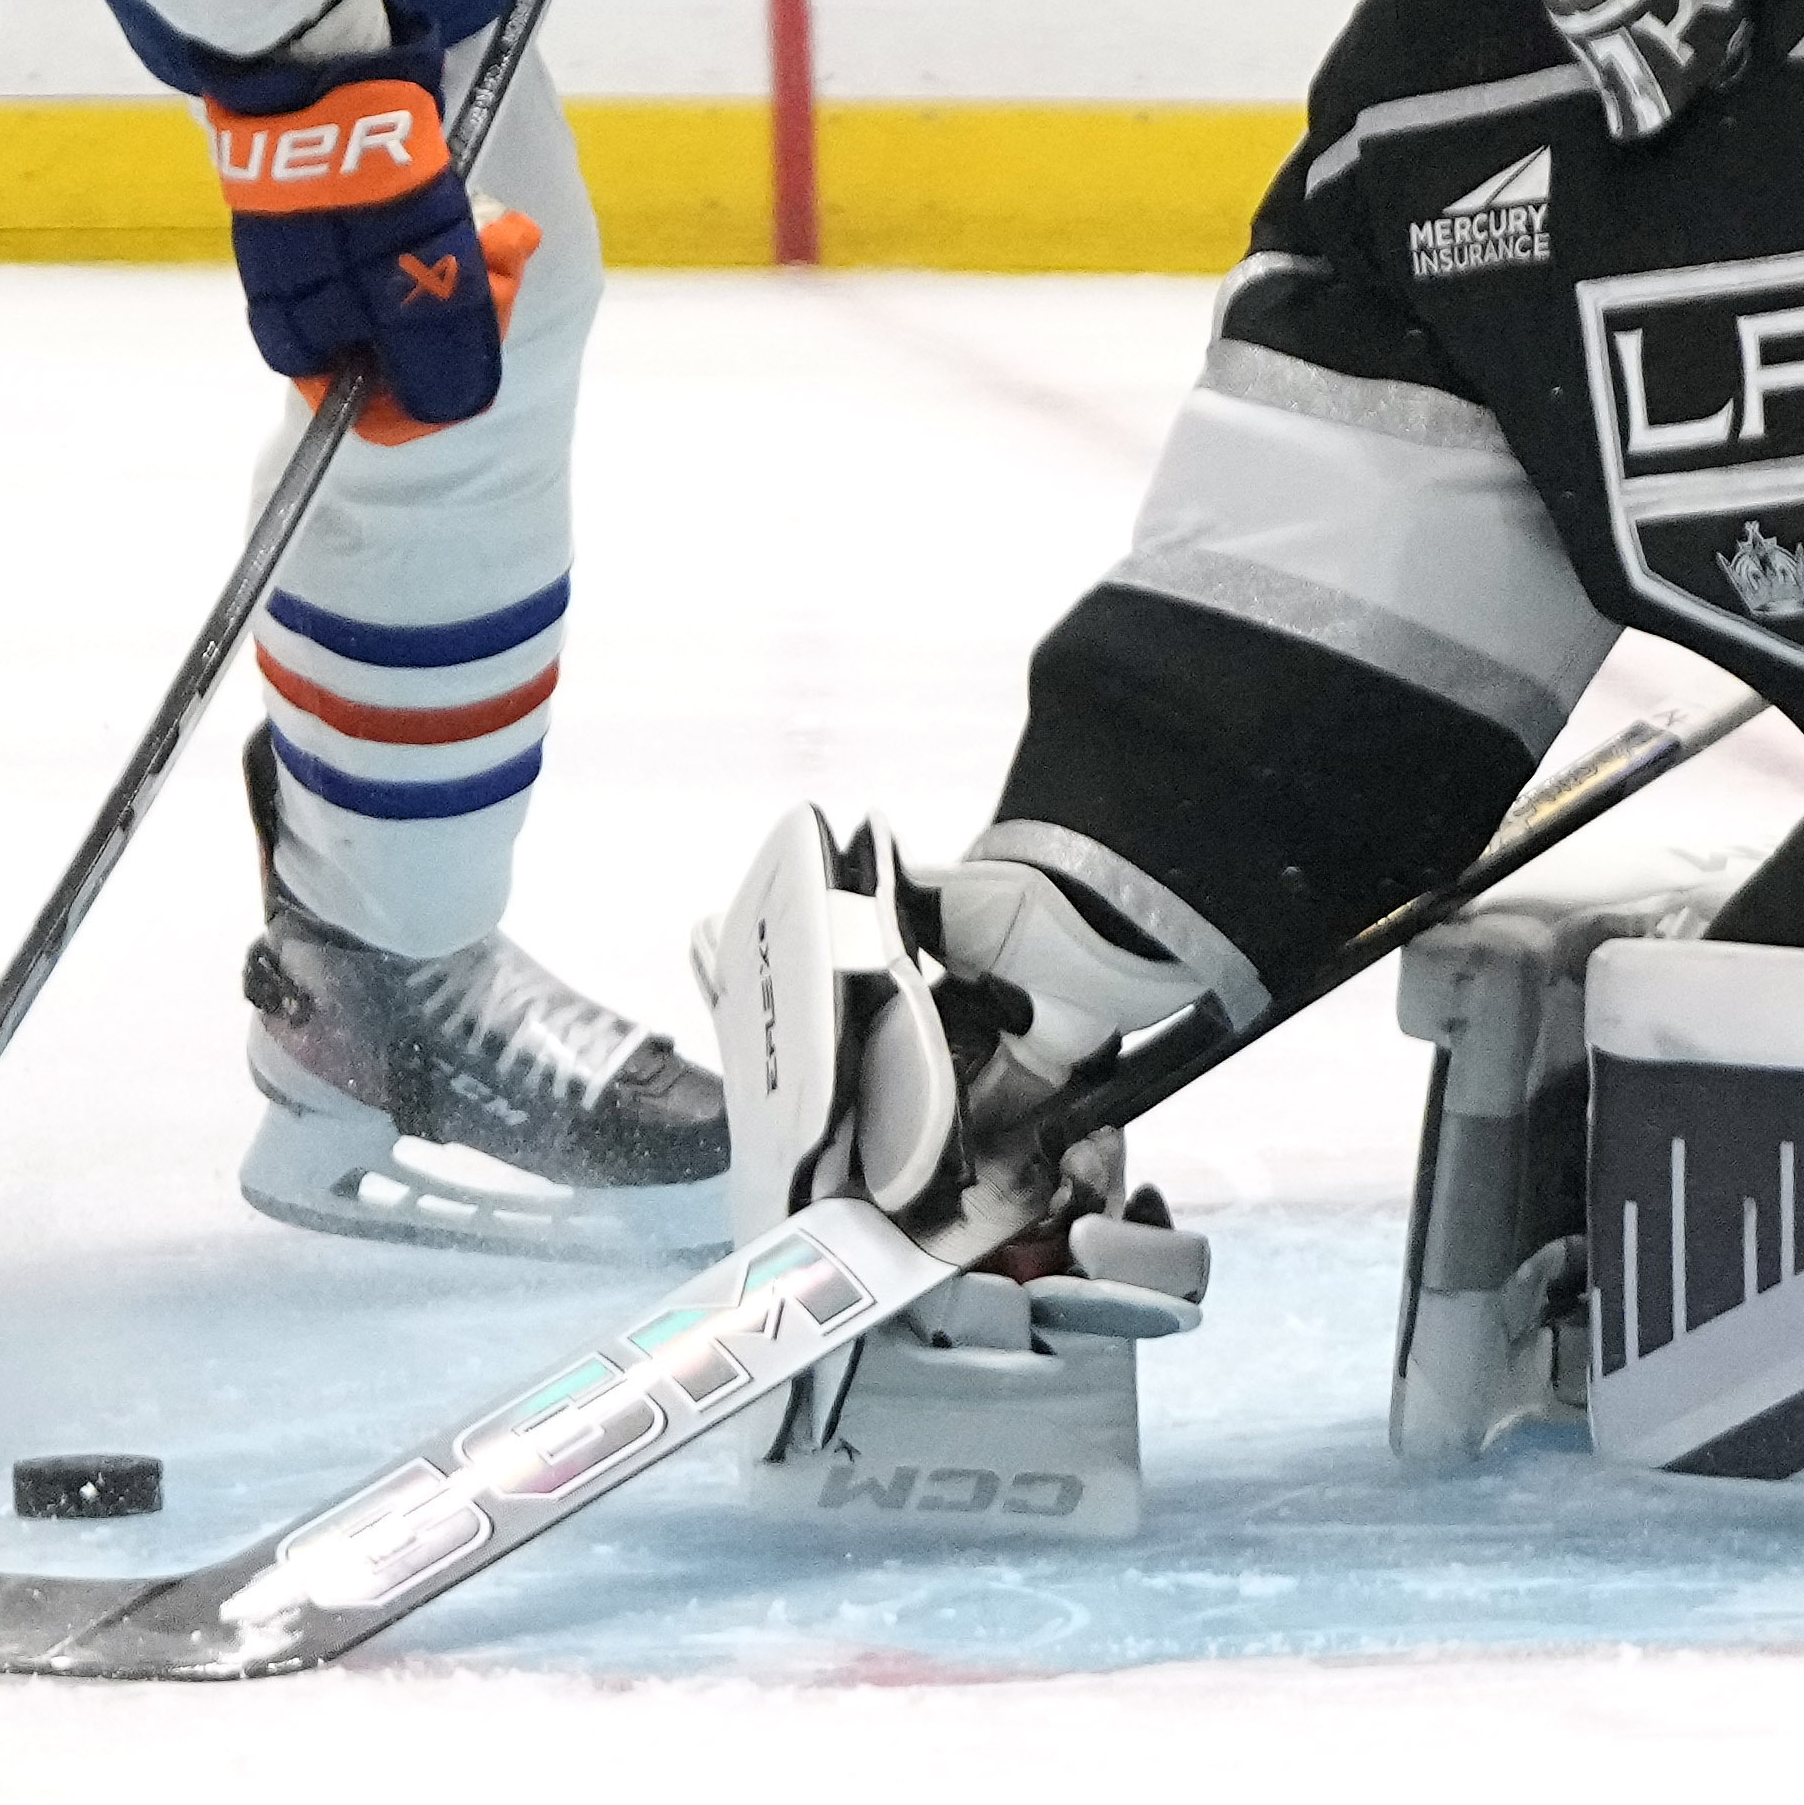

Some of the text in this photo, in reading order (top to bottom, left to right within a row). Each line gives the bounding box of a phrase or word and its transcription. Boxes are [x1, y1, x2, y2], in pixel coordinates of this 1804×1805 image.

[1409, 203, 1548, 251] MERCURY
[1411, 231, 1551, 276] INSURANCE
[276, 1225, 879, 1610] CCM
[817, 1463, 1086, 1517] CCM
